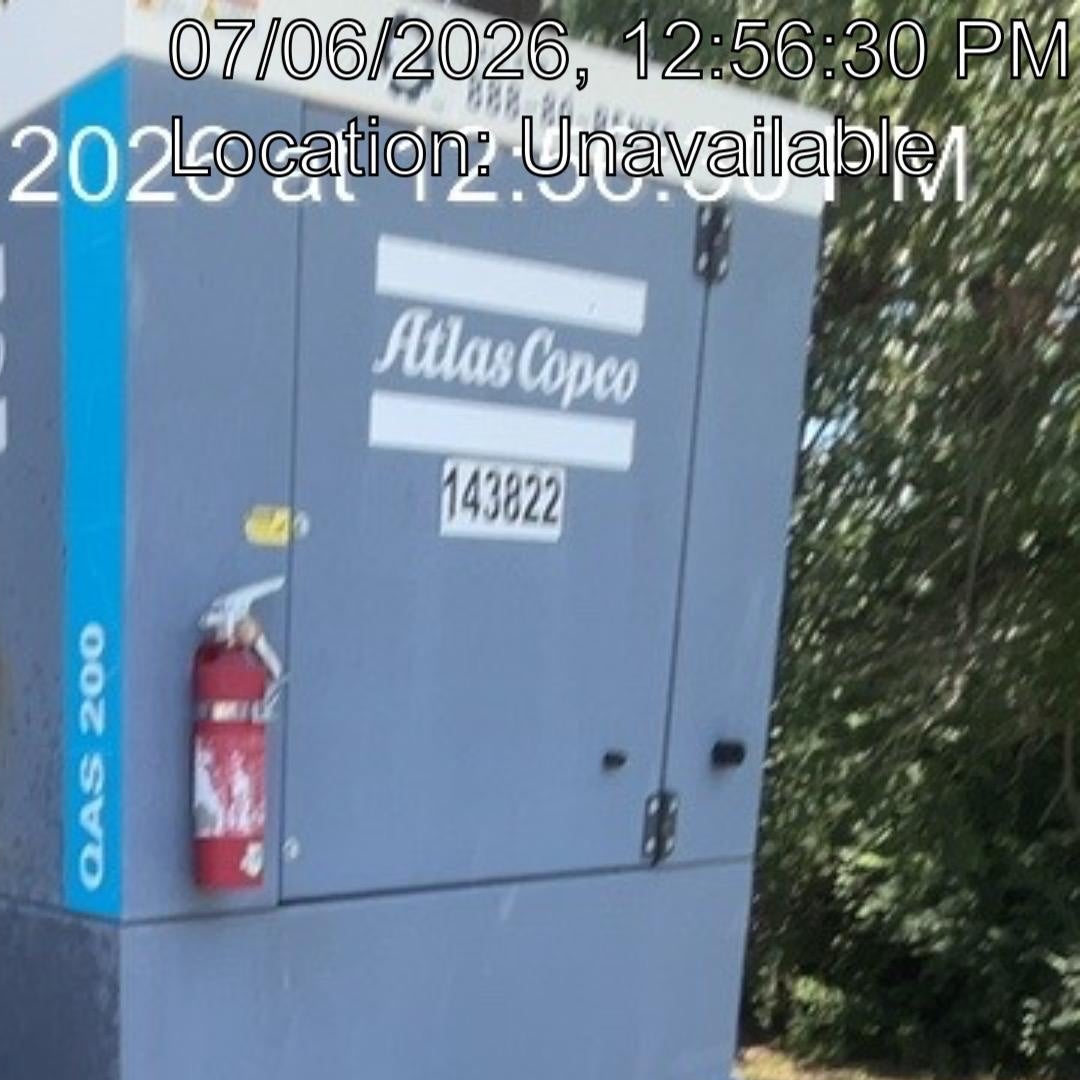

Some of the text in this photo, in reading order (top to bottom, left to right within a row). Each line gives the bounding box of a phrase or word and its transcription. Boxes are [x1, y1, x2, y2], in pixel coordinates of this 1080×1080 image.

[371, 305, 640, 410] Atlas Copco
[444, 466, 561, 524] 143822
[79, 621, 105, 891] QAS 200
